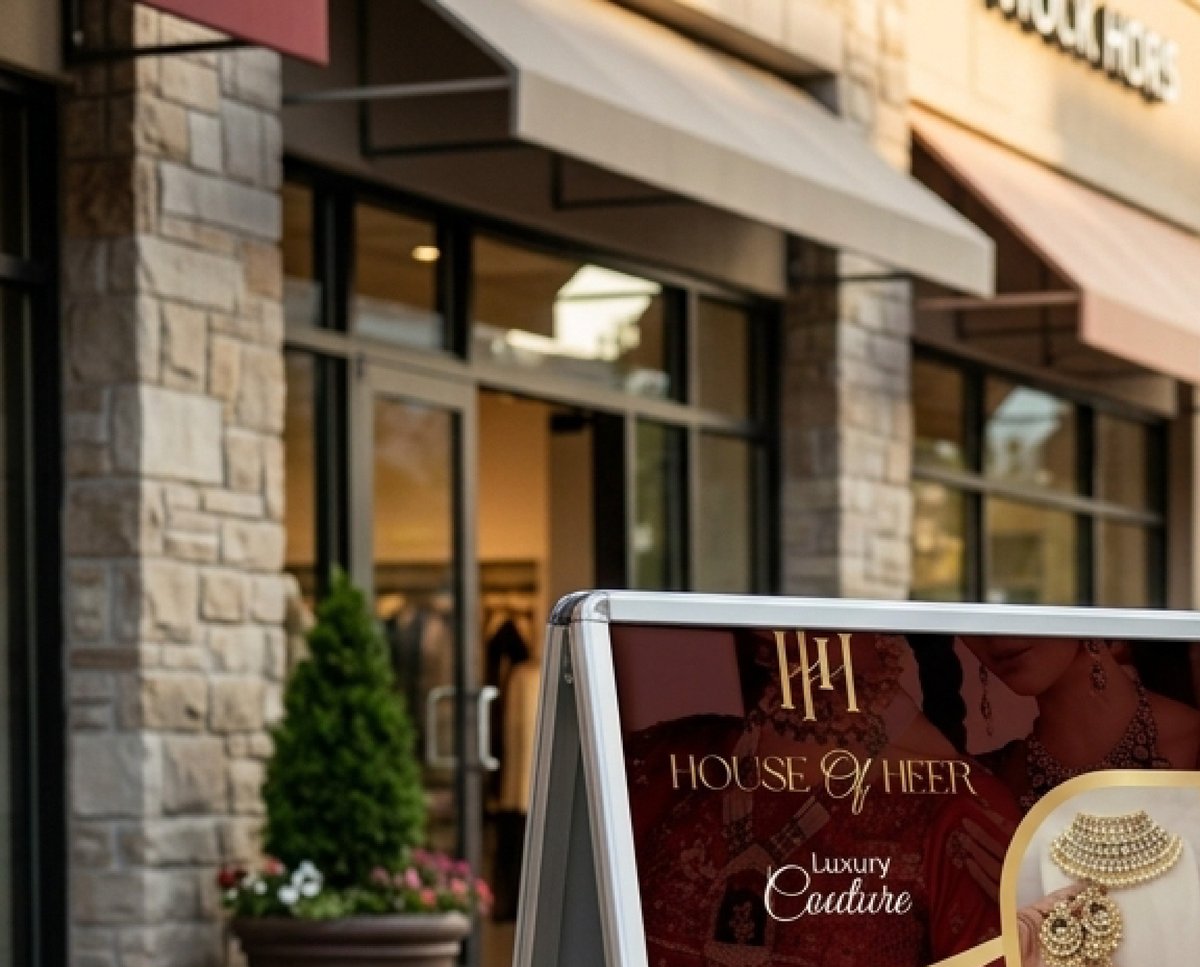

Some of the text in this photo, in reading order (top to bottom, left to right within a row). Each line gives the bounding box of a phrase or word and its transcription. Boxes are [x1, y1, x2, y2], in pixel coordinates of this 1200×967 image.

[670, 749, 979, 816] HOUSE Of HEER
[811, 851, 892, 879] Luxury
